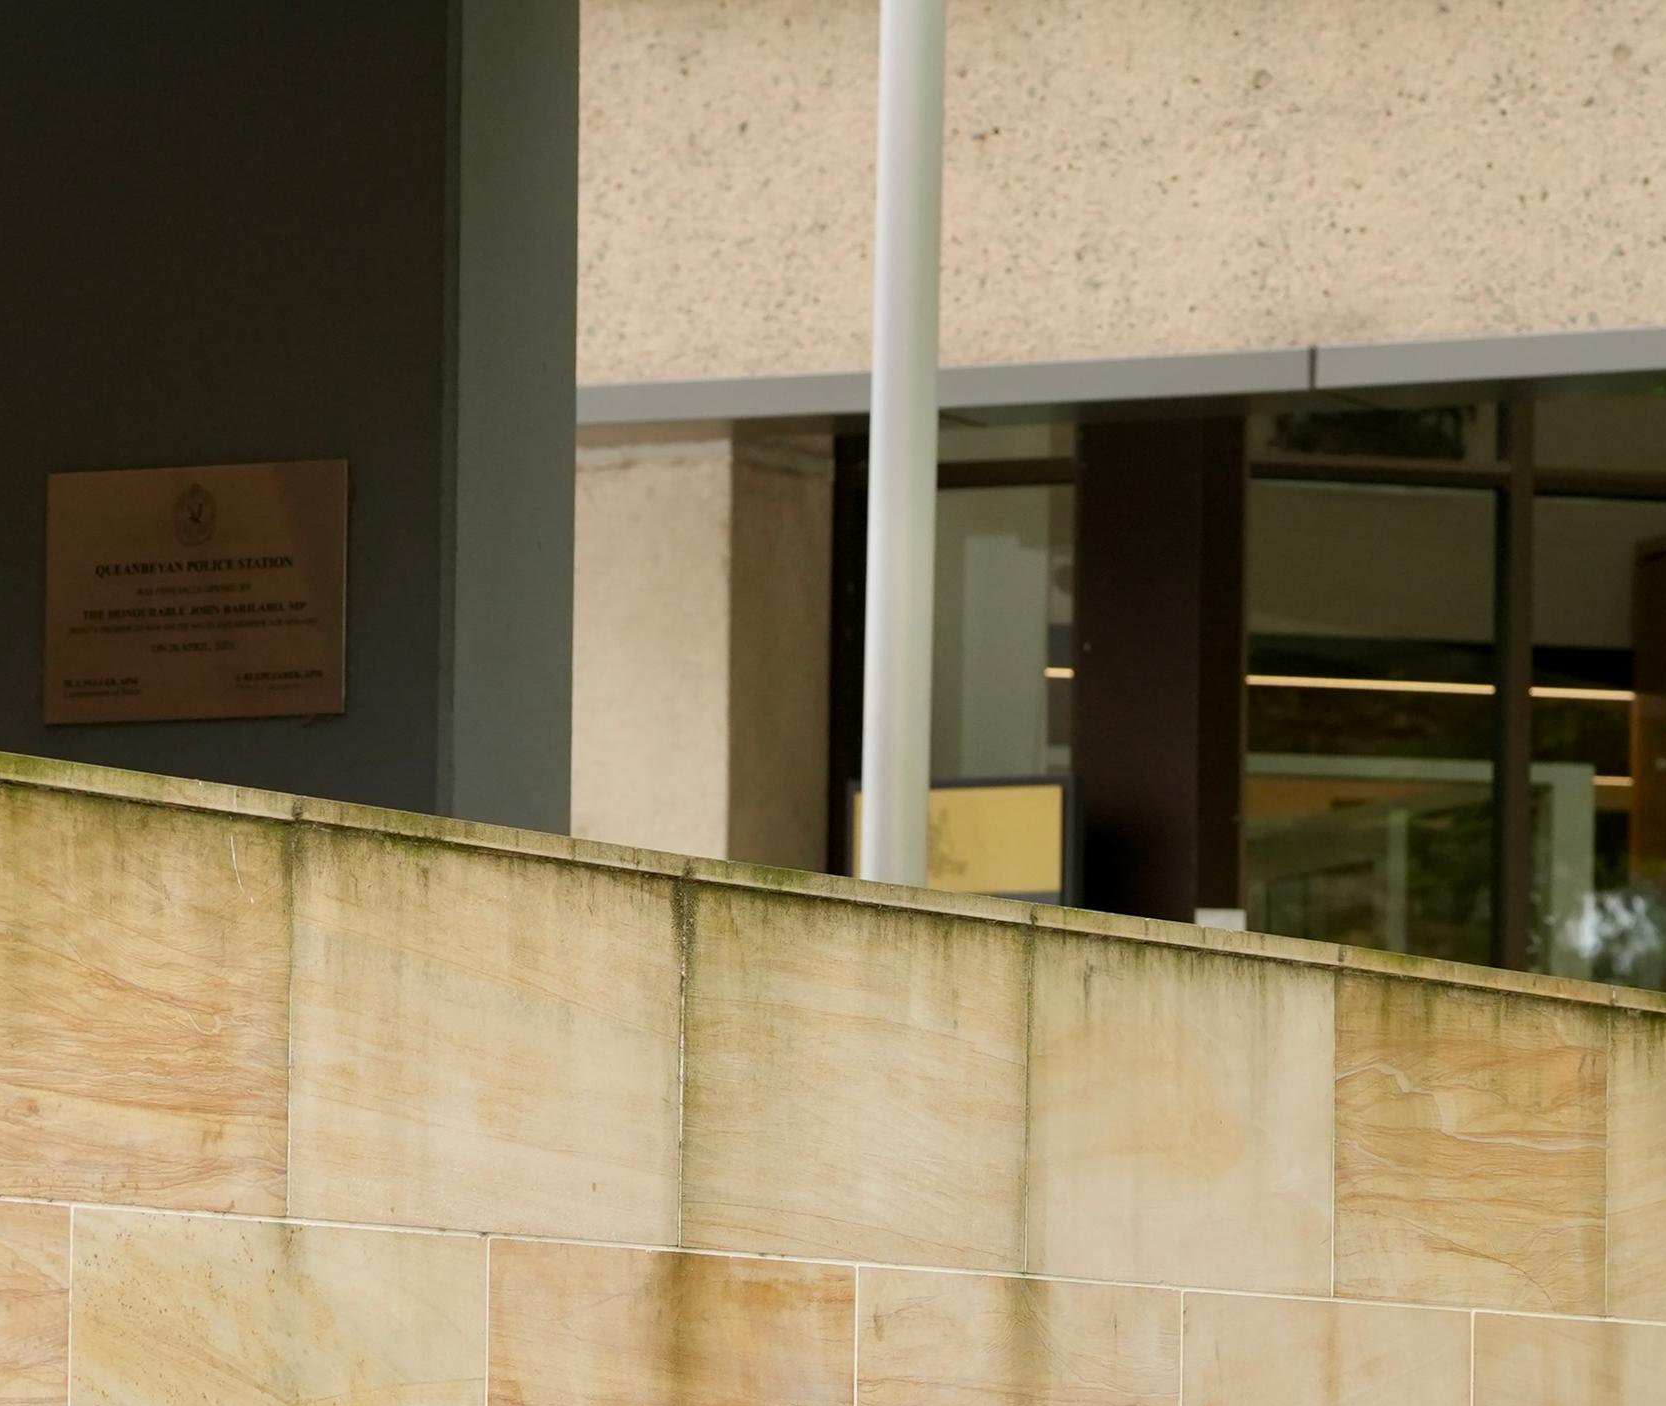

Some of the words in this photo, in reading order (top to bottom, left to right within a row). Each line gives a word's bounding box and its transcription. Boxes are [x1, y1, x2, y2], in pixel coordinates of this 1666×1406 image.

[95, 562, 183, 578] QUEANBEYAN
[186, 559, 233, 573] POLICE
[236, 556, 293, 570] STATION
